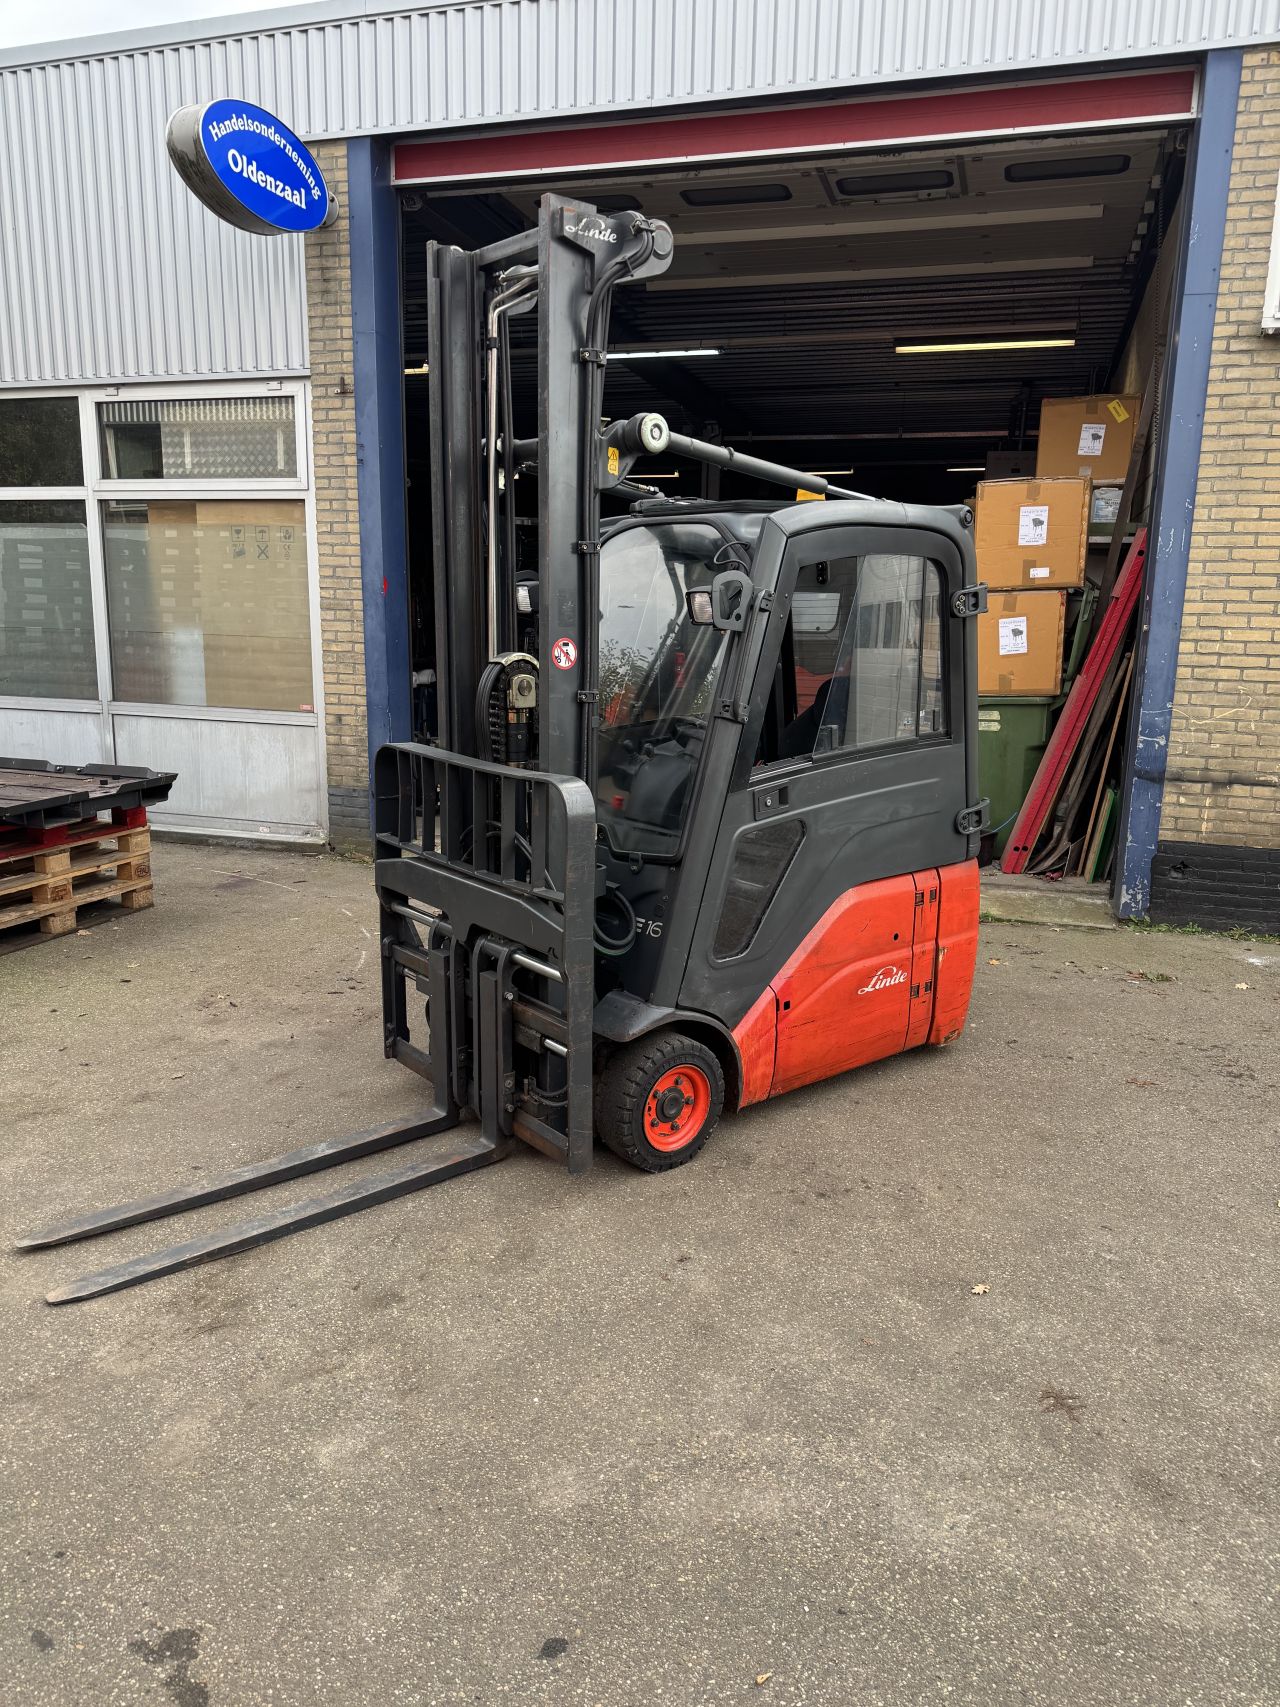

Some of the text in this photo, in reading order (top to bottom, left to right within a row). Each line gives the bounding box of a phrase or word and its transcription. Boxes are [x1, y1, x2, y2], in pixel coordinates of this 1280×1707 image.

[209, 113, 322, 201] Handelsonderneming
[227, 148, 307, 209] Oldenzaal
[857, 965, 908, 995] Linde
